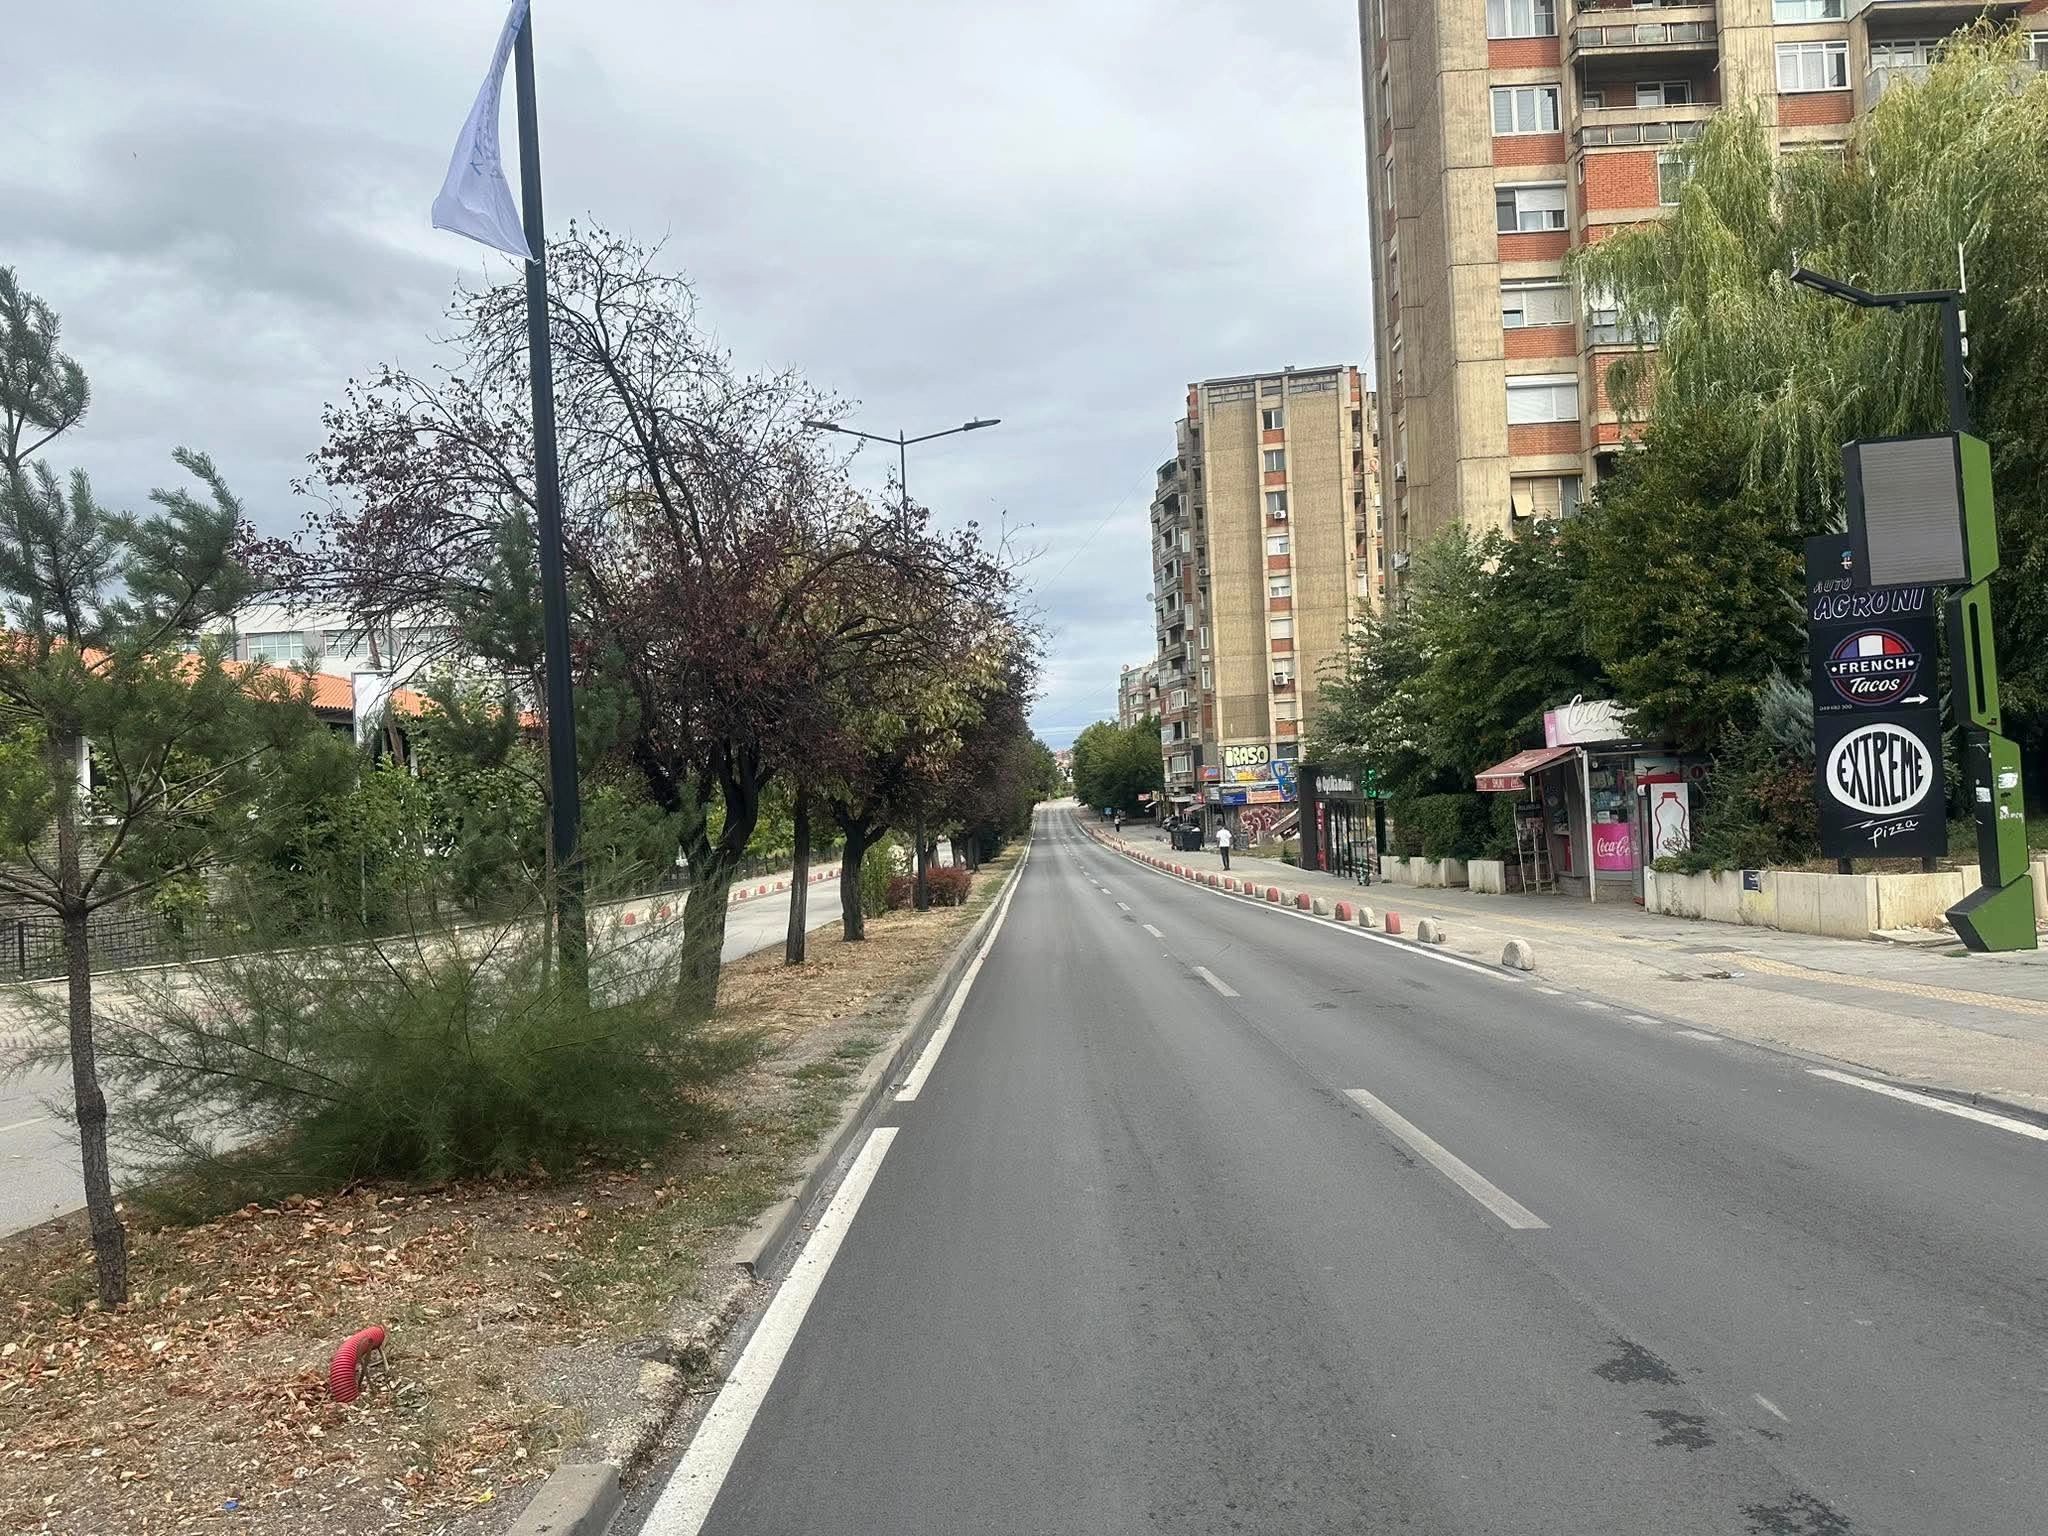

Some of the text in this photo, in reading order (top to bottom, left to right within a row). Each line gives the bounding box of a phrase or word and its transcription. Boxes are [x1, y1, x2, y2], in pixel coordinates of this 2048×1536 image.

[1813, 577, 1852, 594] AUTO
[1813, 588, 1925, 620] AGRONI
[1839, 658, 1907, 674] FRENCH
[1850, 677, 1900, 694] Tacos
[1837, 731, 1924, 807] EXTREME
[1868, 820, 1919, 848] pizza
